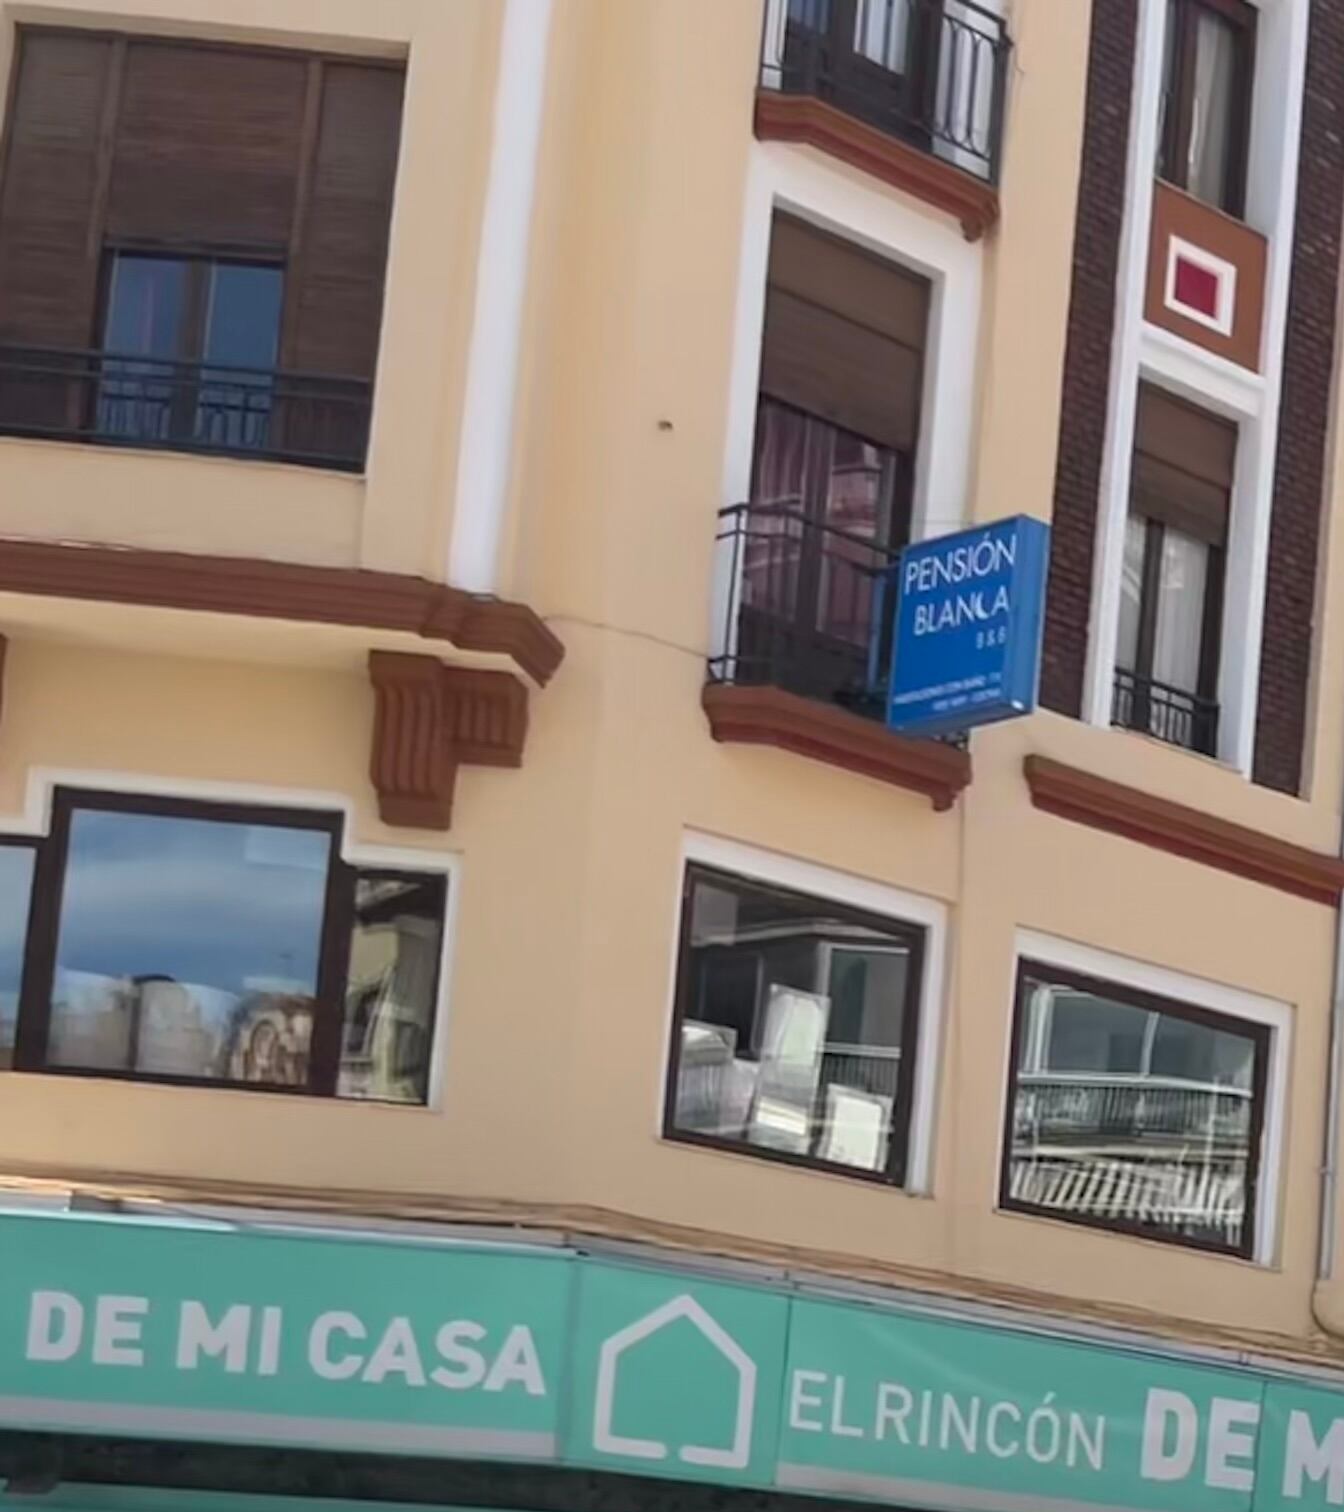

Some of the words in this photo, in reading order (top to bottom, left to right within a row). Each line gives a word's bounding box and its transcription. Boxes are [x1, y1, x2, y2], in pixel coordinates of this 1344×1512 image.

[905, 531, 1017, 595] PENSIÓN
[914, 585, 1010, 636] BLANCA
[26, 1290, 149, 1366] DE
[175, 1300, 282, 1375] MI
[308, 1311, 546, 1395] CASA
[1140, 1387, 1262, 1493] DE
